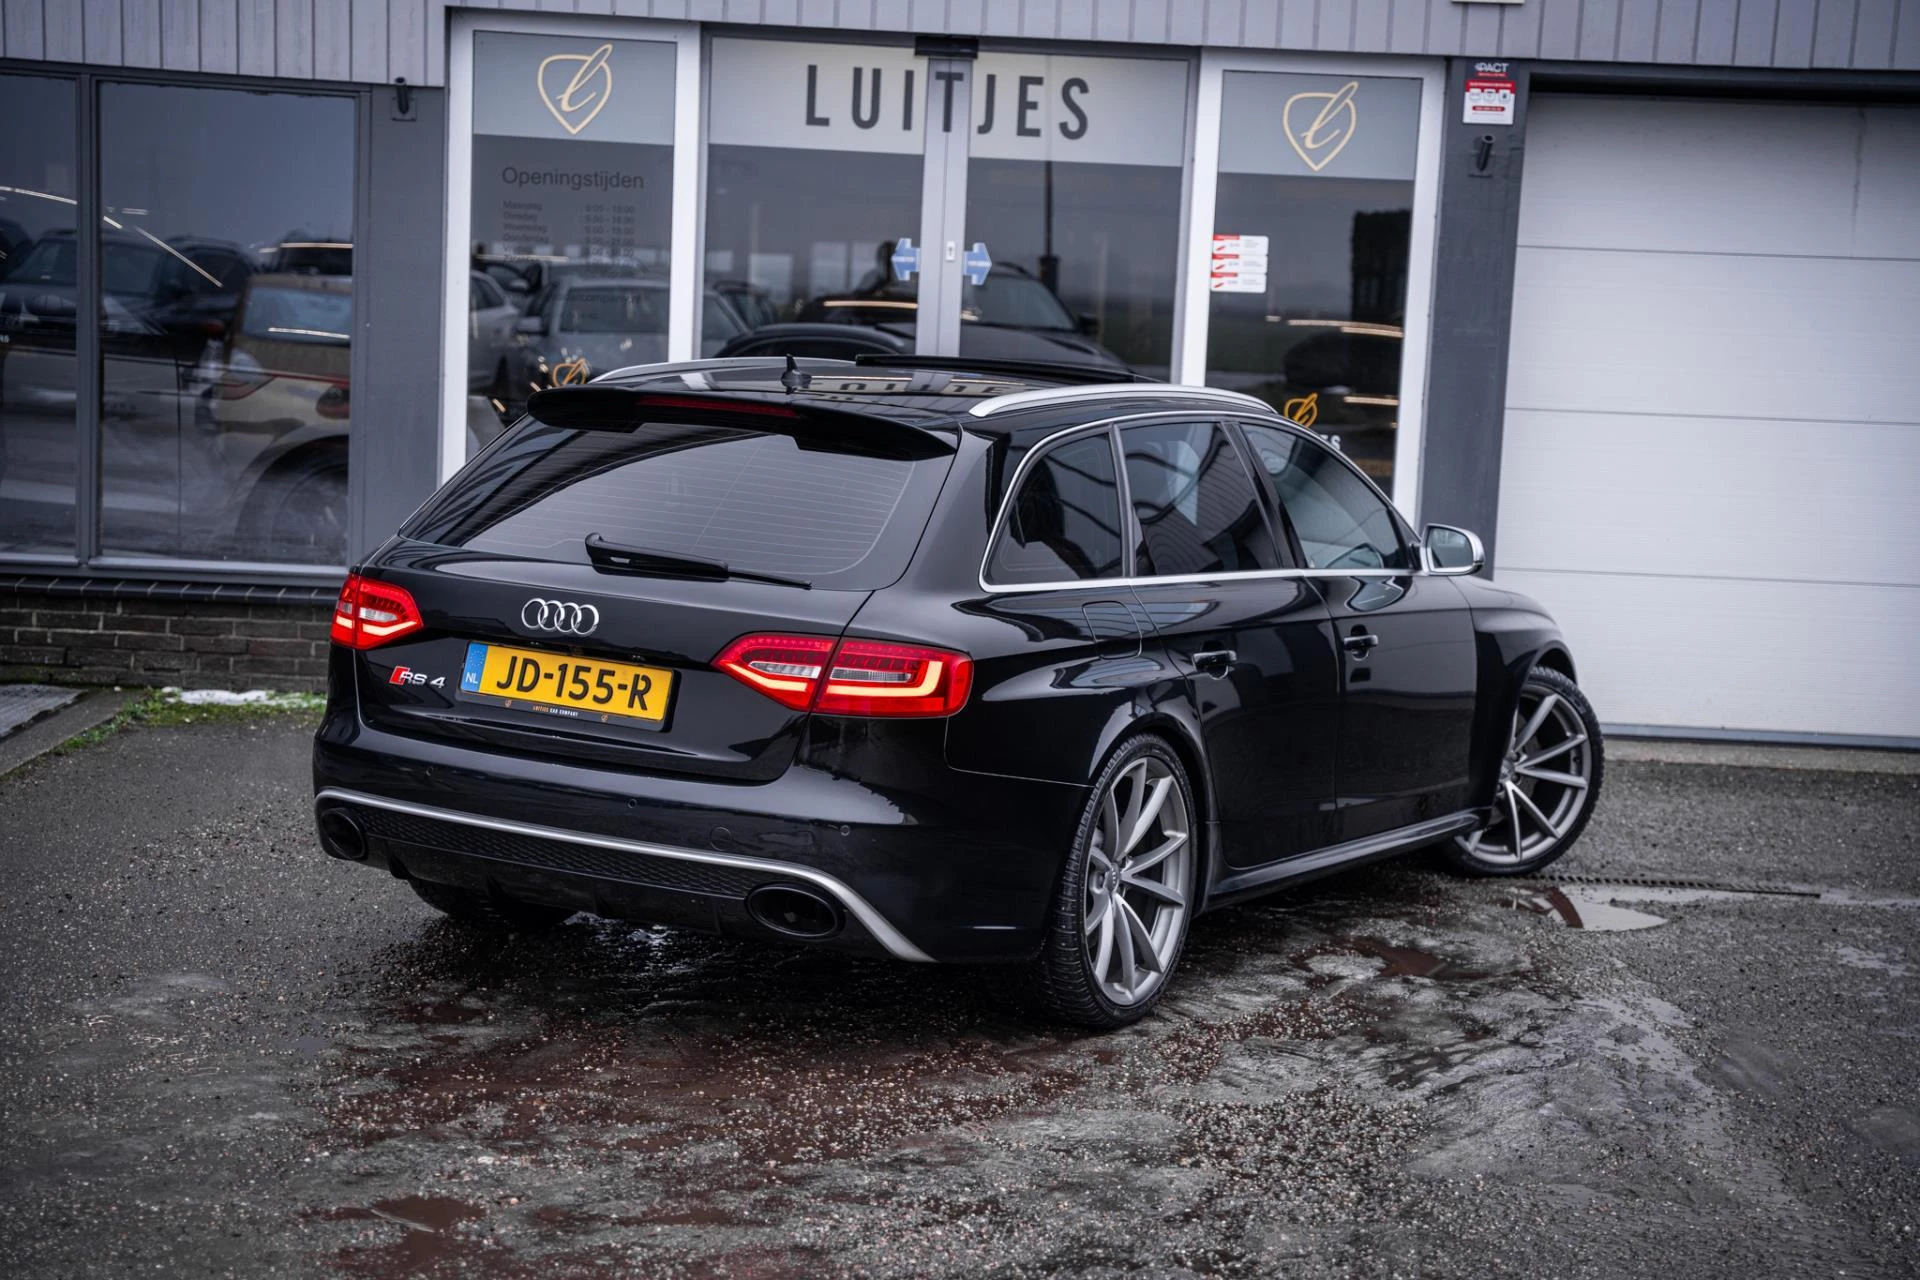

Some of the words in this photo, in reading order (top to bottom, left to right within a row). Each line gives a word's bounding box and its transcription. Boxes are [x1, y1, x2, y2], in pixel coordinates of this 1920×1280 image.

[806, 64, 1090, 140] LUITJES
[502, 166, 645, 192] Openingstijden
[465, 672, 478, 684] NL
[497, 655, 652, 711] JD-155-R
